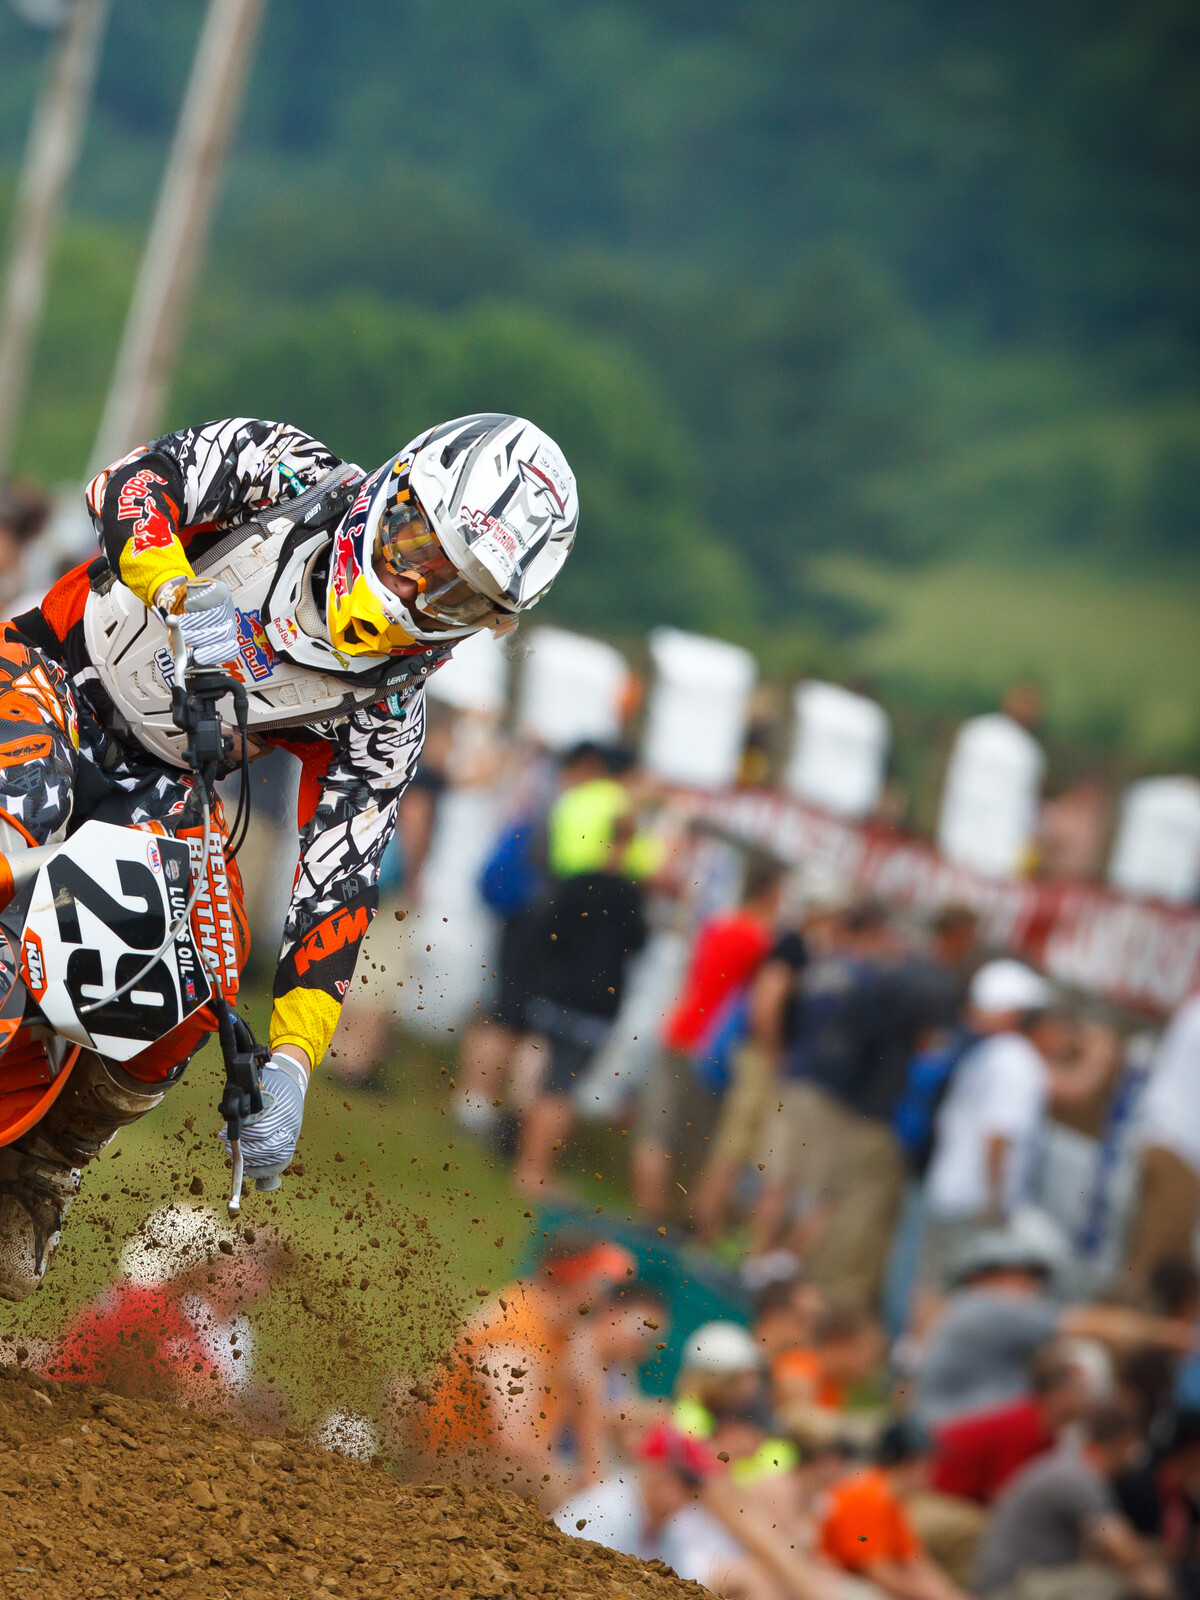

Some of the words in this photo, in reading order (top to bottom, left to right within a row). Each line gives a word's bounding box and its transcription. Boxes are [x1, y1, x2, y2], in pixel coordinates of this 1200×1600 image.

[169, 887, 191, 943] LUCS
[187, 836, 222, 985] RENTHAL
[209, 832, 238, 988] RENTHAL
[294, 906, 369, 977] KTM
[25, 940, 44, 990] KTM
[47, 853, 179, 1042] 29
[178, 947, 195, 978] OIL
